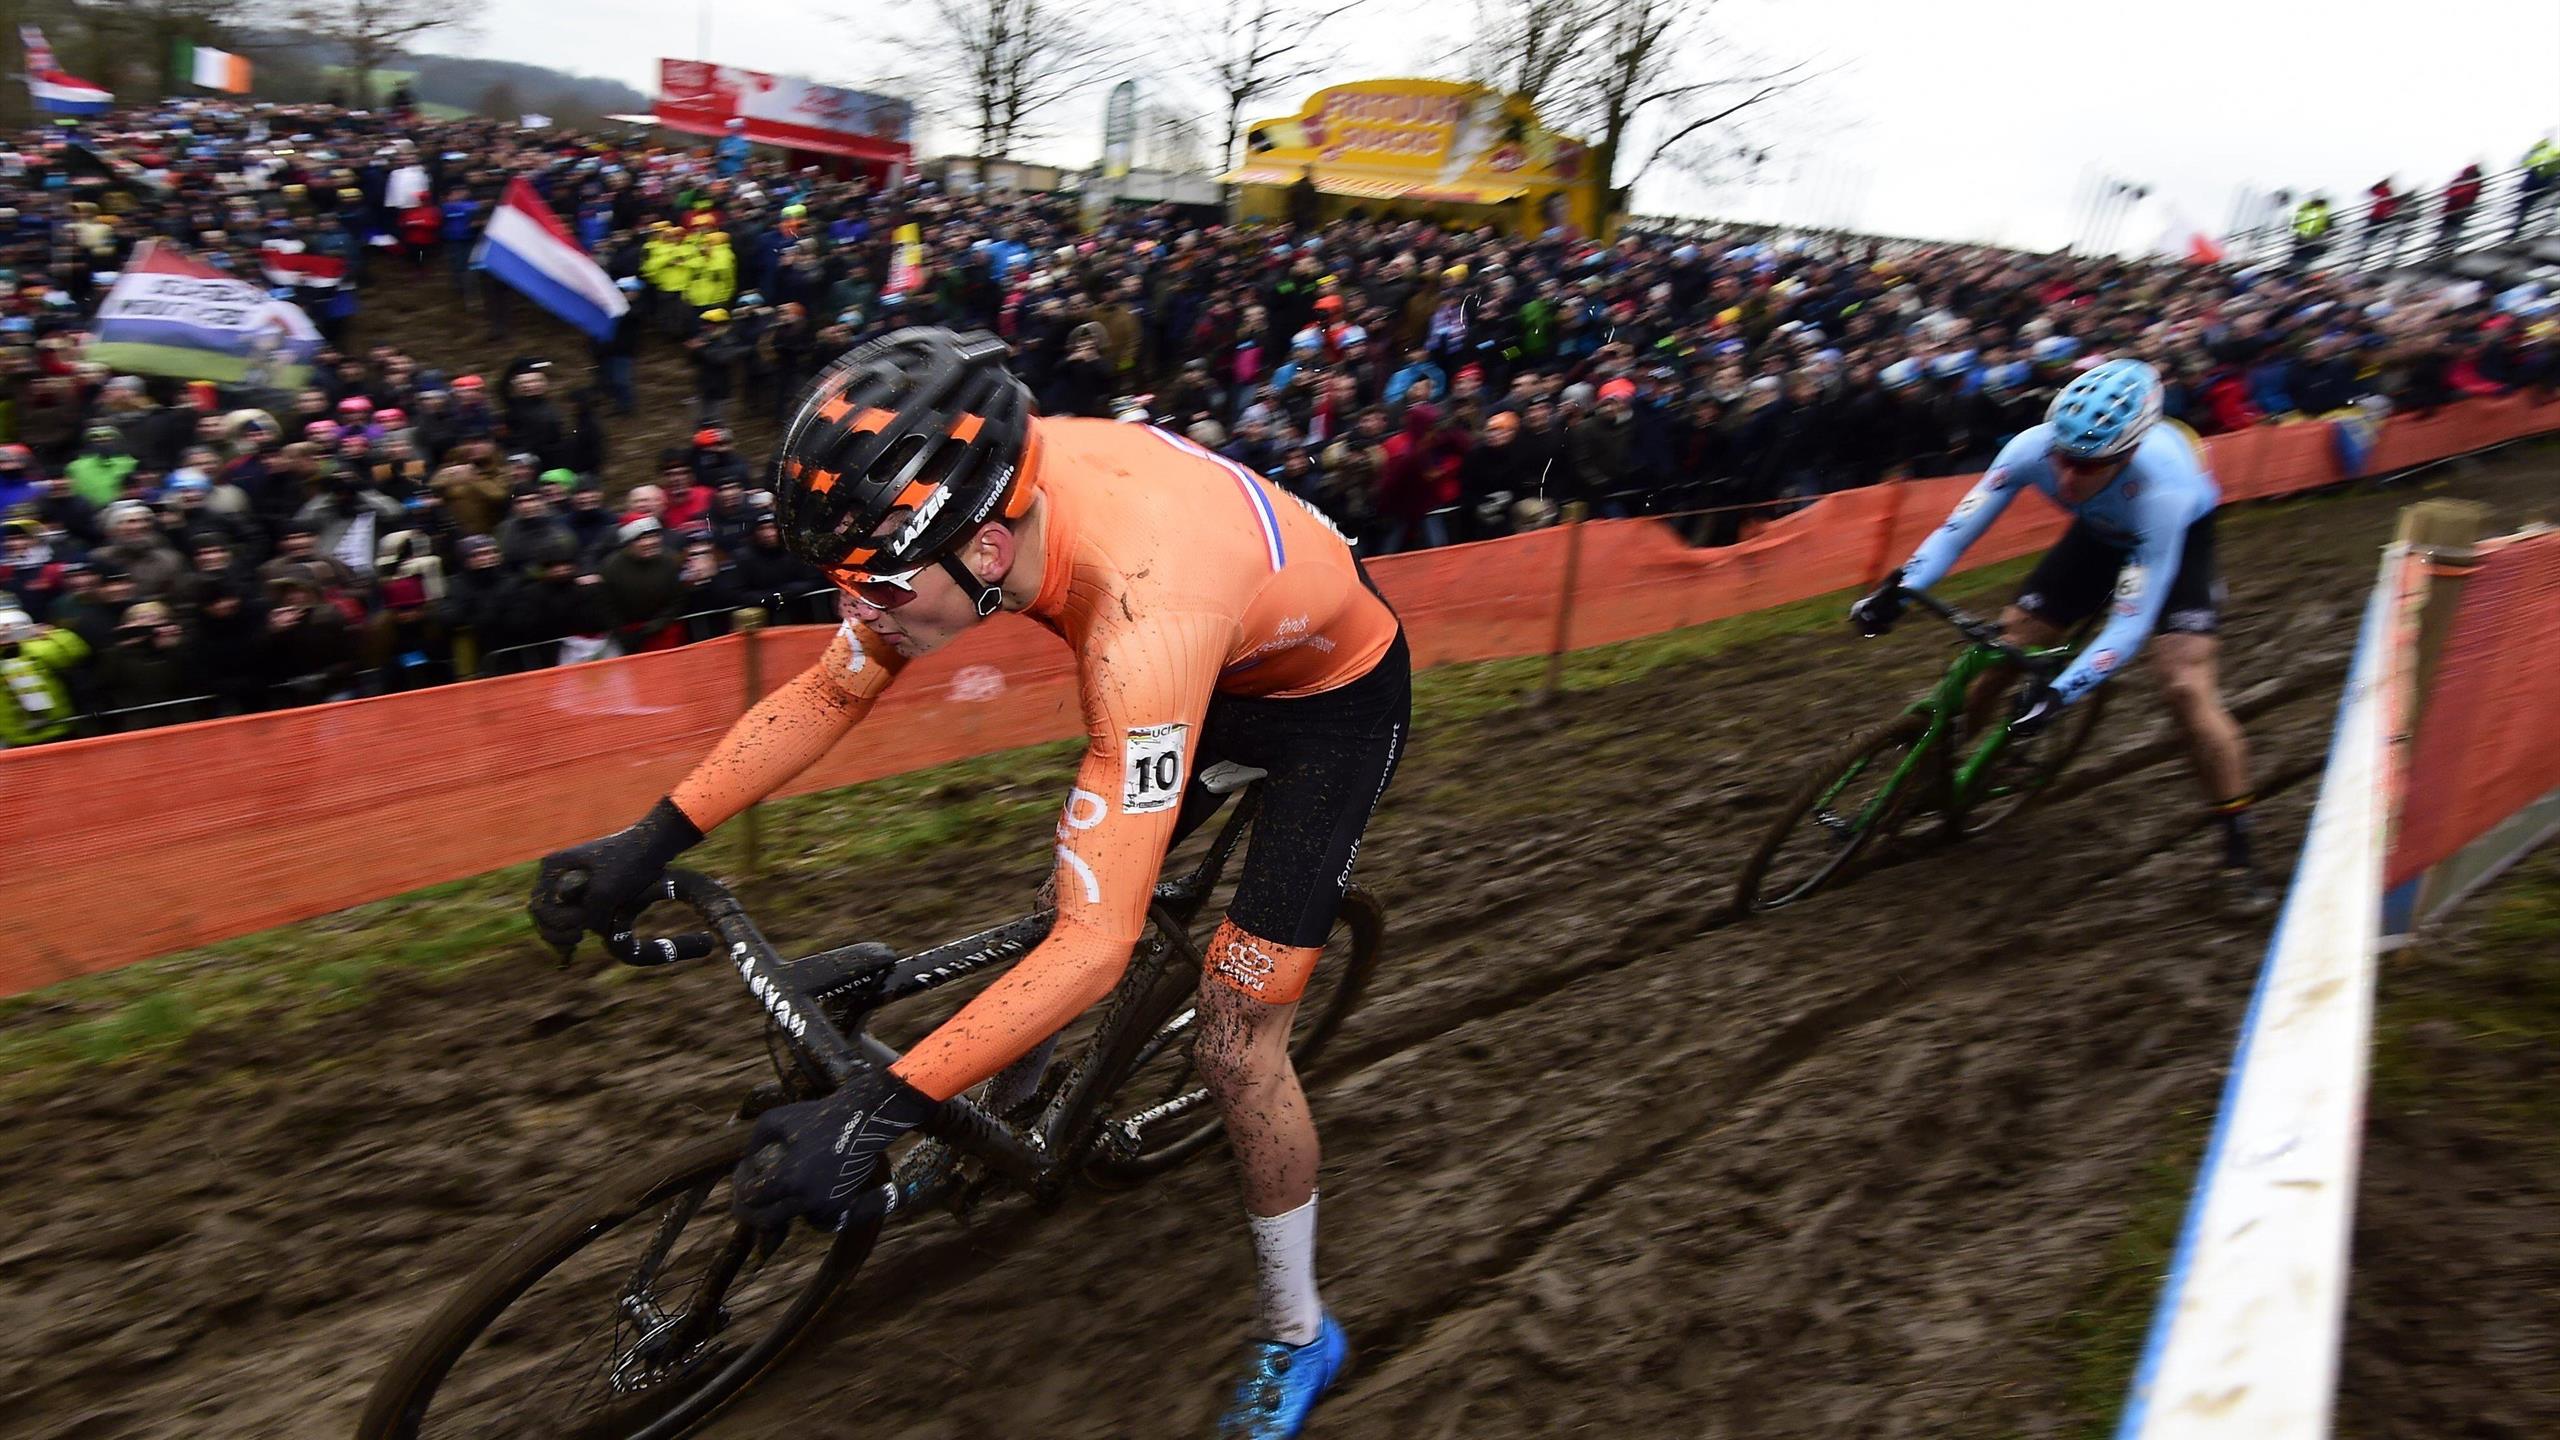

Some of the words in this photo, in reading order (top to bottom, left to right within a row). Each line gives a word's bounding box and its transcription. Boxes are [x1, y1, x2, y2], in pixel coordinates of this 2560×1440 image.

[892, 485, 953, 556] LAZER
[1152, 726, 1171, 738] UCI
[1135, 750, 1180, 795] 10
[1337, 837, 1361, 888] fonds
[817, 975, 872, 1003] CANYON
